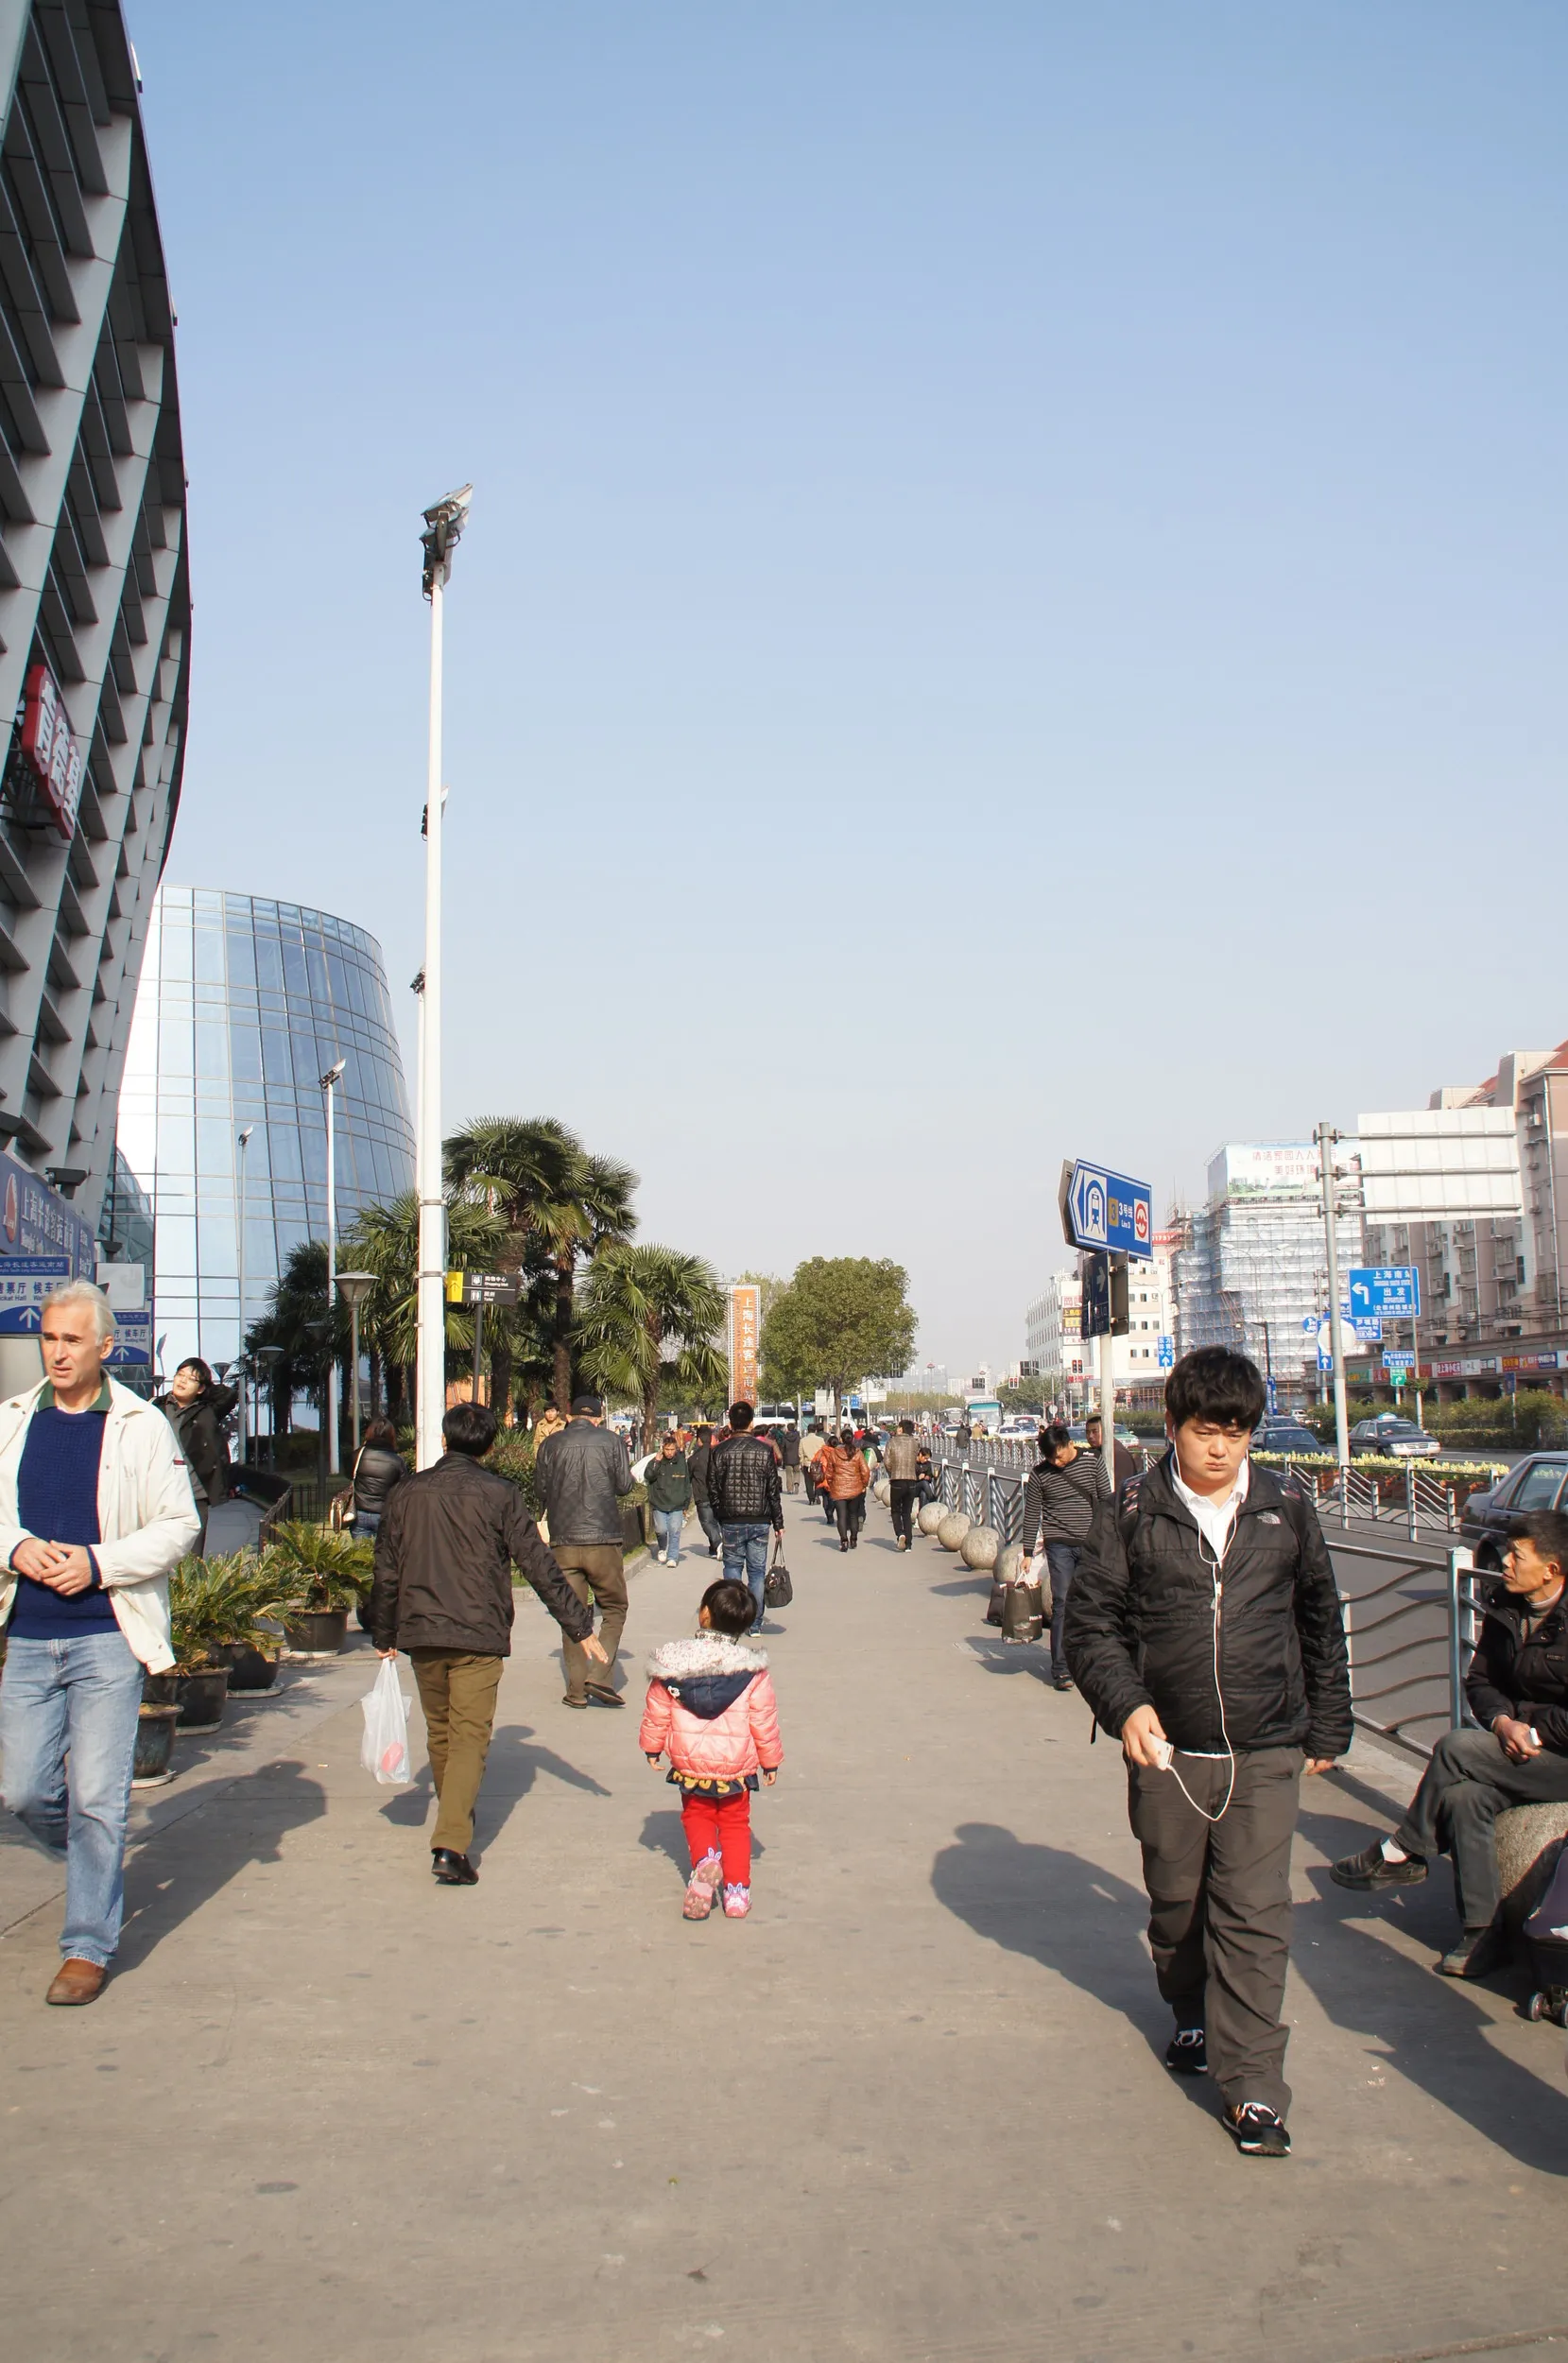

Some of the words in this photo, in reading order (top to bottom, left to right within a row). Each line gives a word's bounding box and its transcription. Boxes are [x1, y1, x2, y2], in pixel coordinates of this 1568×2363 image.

[1111, 1203, 1116, 1221] 3
[1119, 1202, 1133, 1219] 3号线
[1373, 1270, 1411, 1279] 上海南站
[1384, 1287, 1405, 1296] 出发
[742, 1297, 754, 1401] 上海长途客运南站
